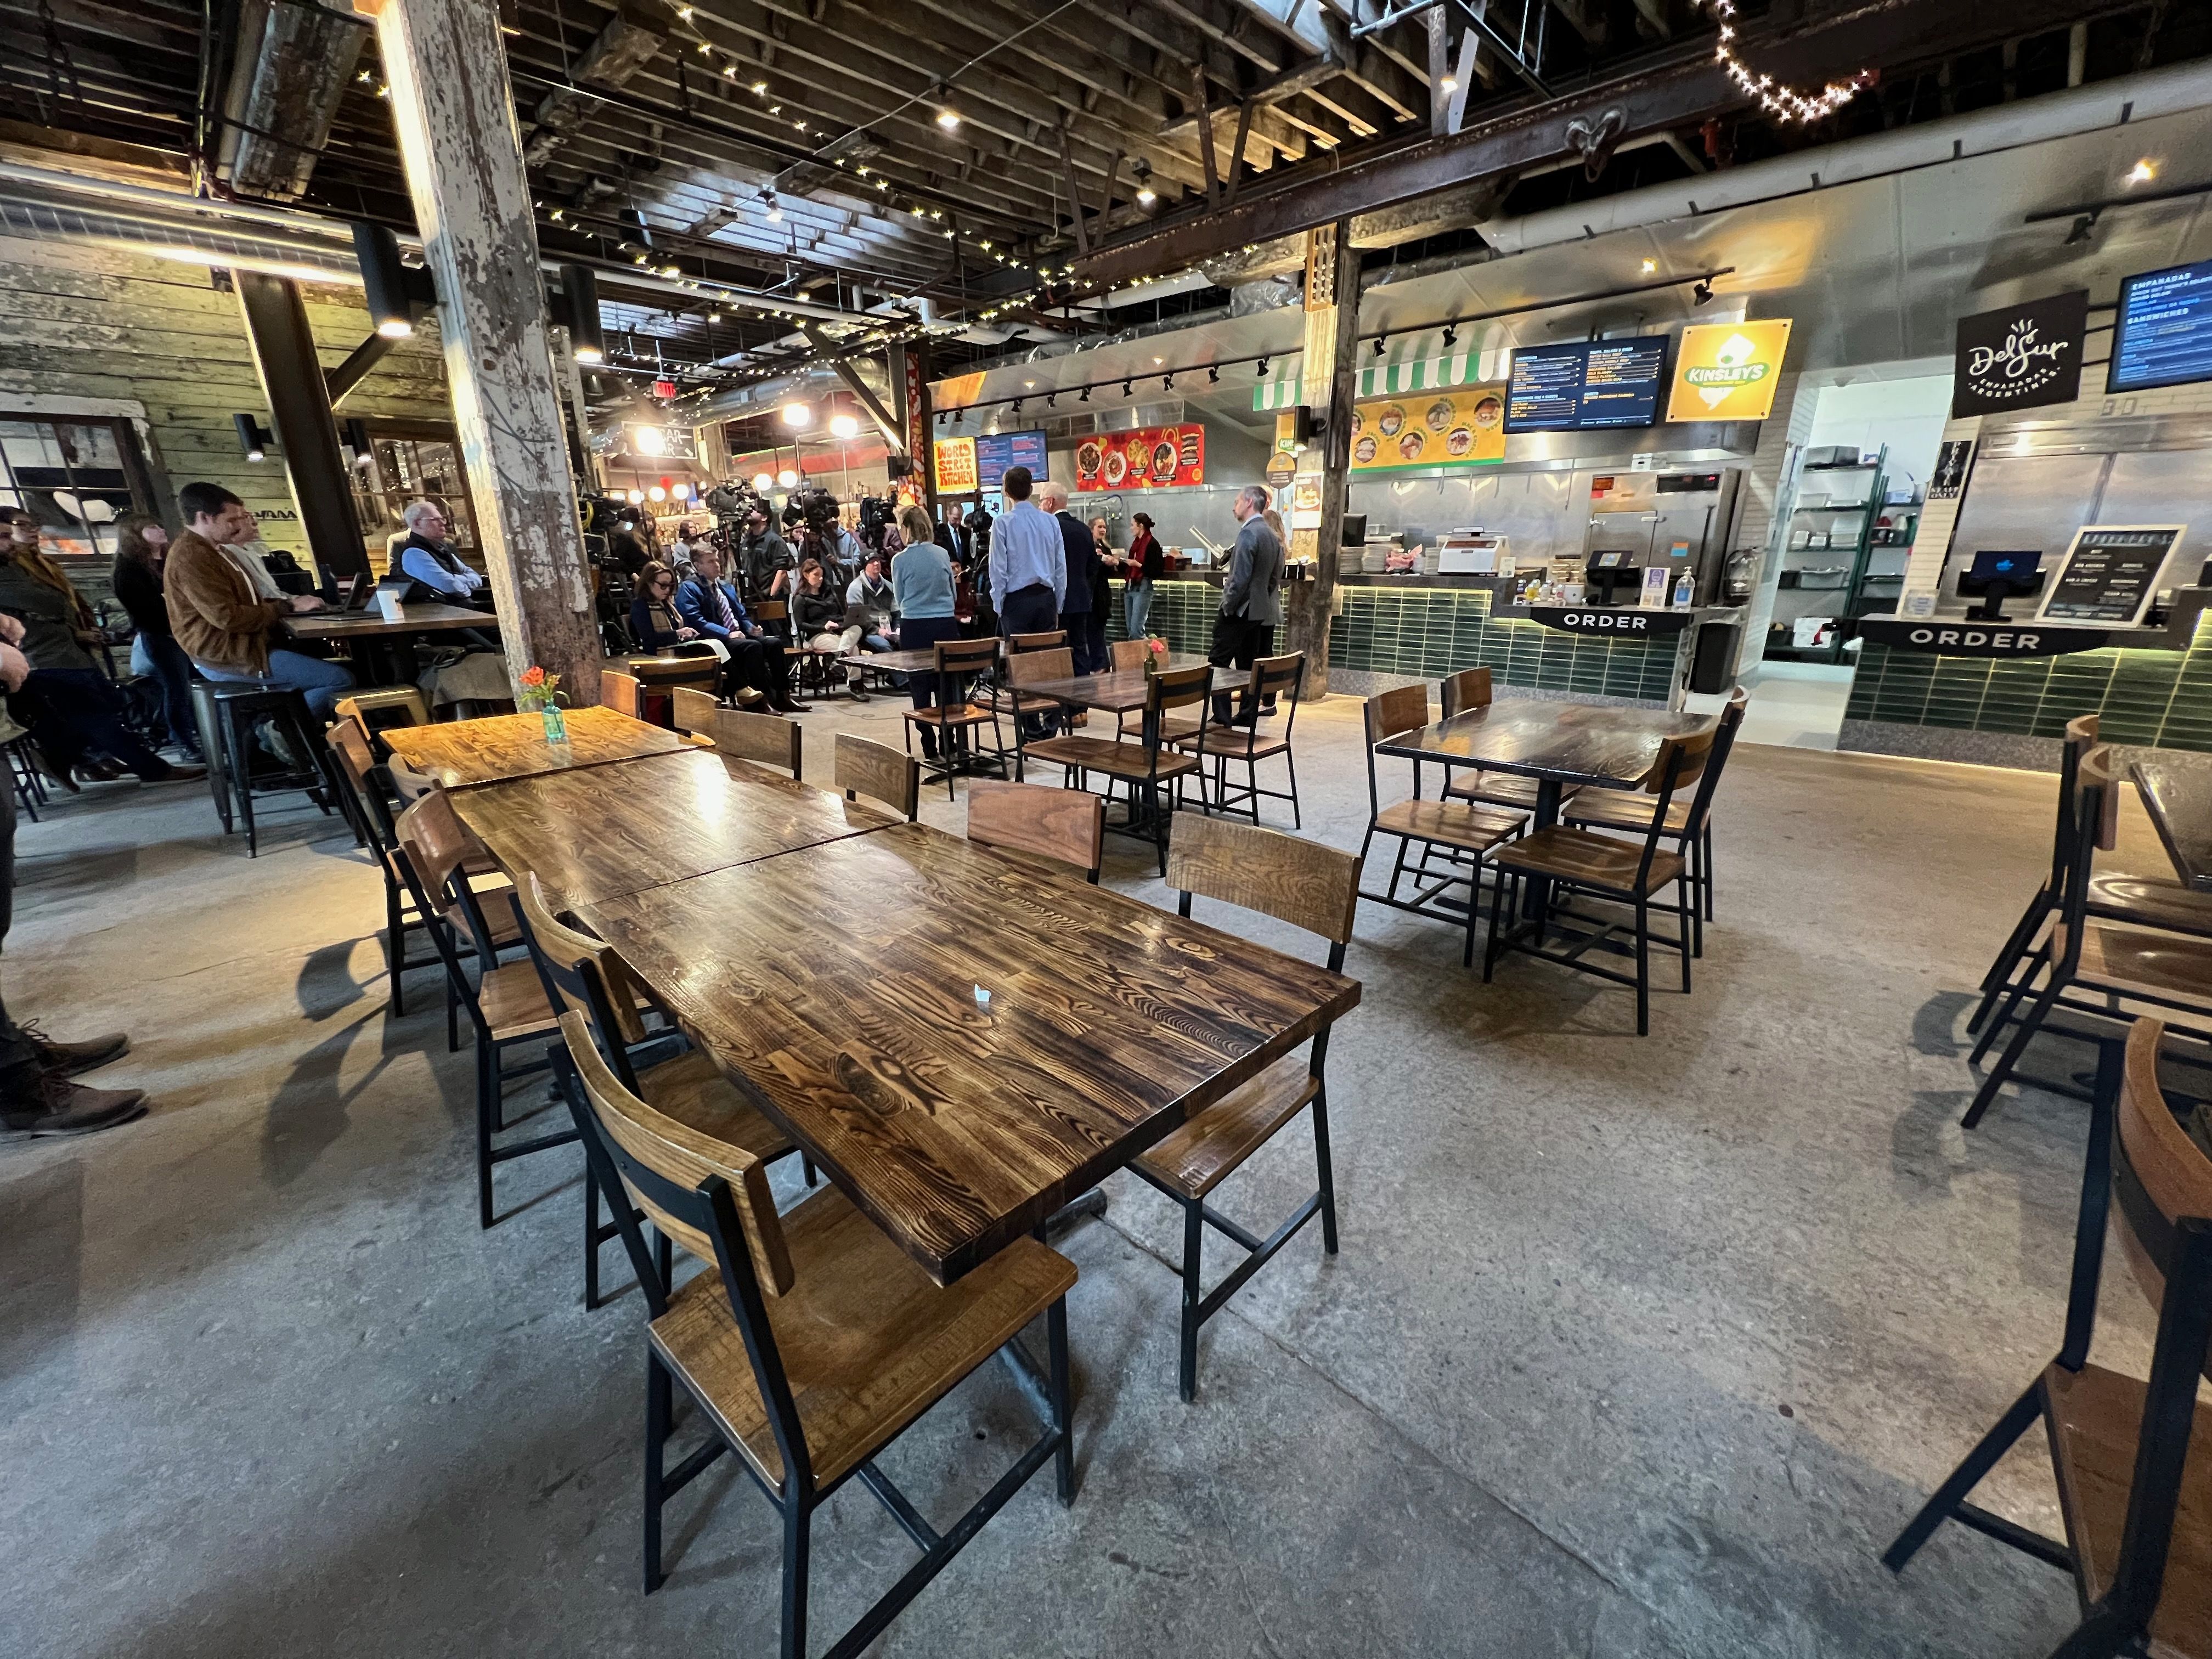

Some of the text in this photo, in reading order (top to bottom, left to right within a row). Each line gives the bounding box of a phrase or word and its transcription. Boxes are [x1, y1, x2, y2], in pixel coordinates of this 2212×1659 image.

[937, 444, 971, 459] WORLD
[939, 471, 973, 486] KITCHEN
[1564, 613, 1647, 629] ORDER
[1910, 629, 2040, 649] ORDER
